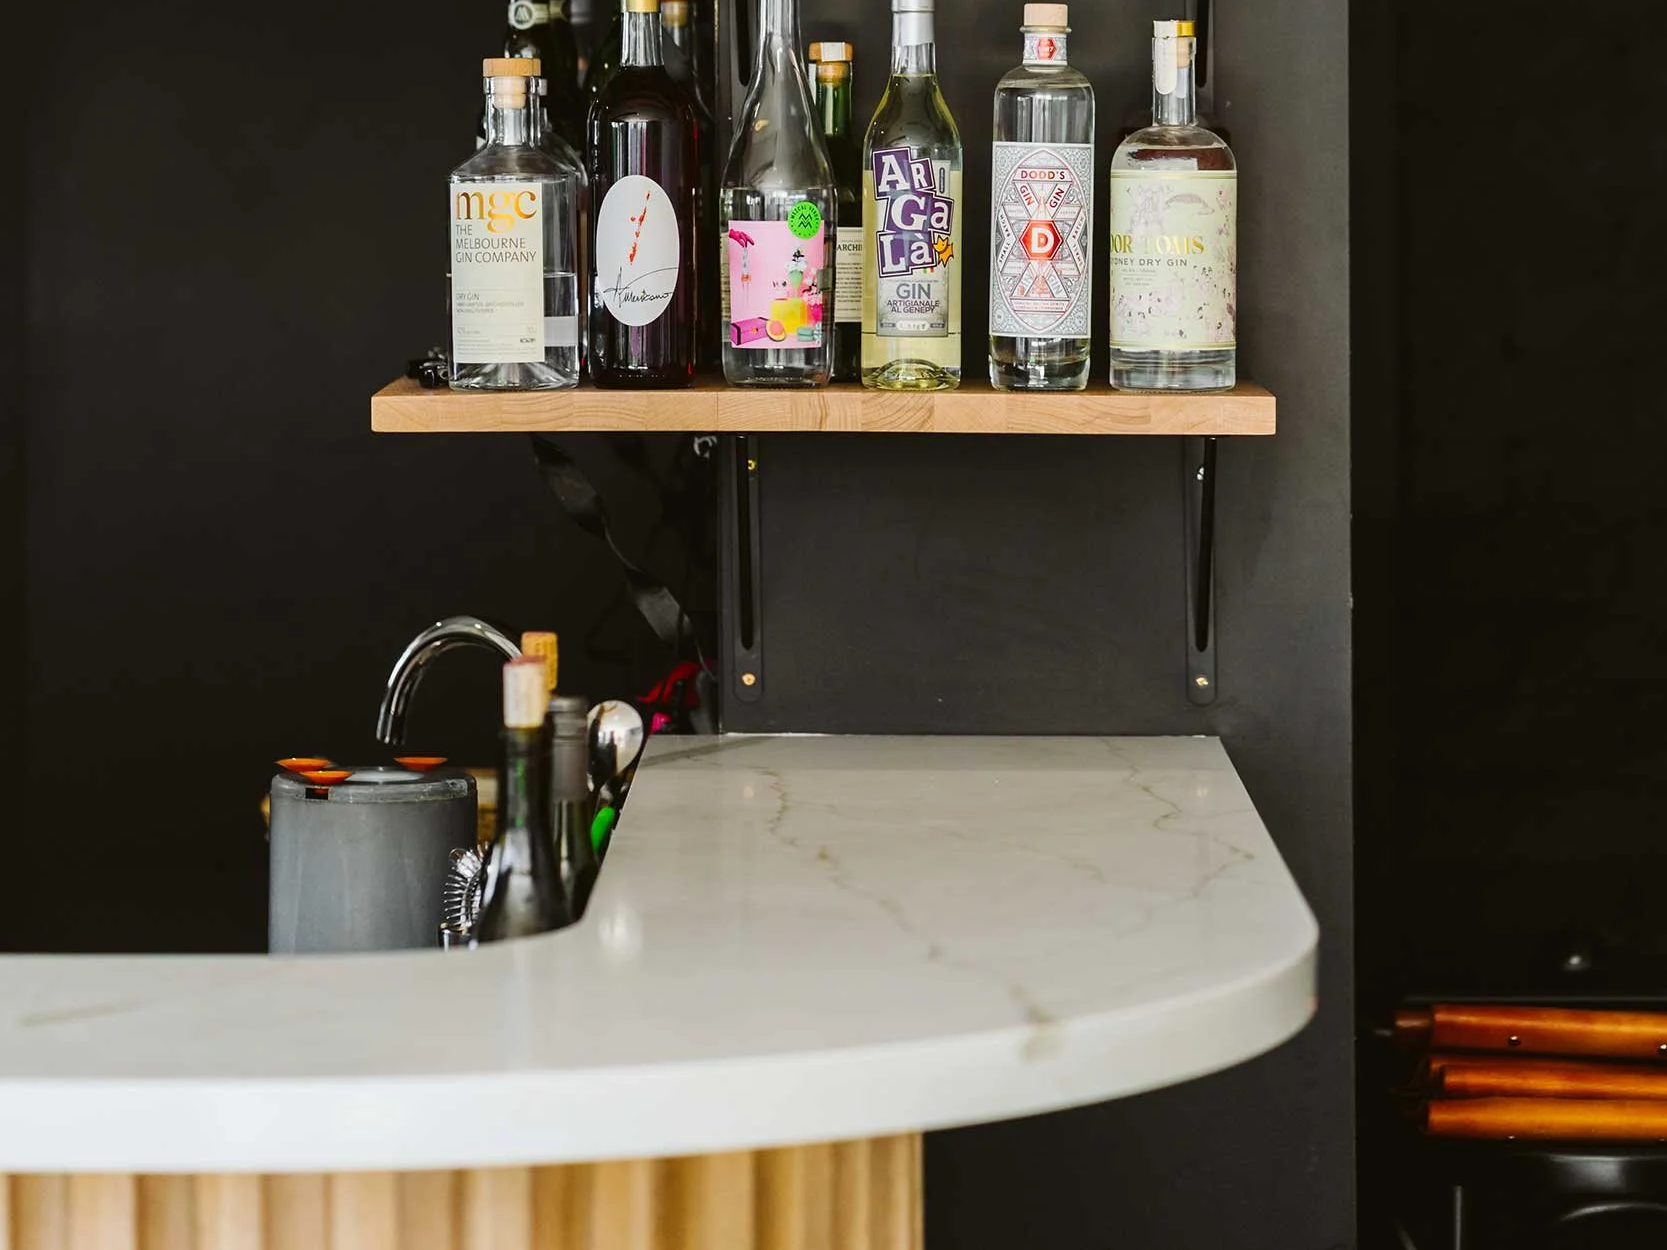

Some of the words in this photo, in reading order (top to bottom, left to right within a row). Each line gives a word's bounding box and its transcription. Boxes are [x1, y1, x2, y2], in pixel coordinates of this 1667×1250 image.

[1020, 170, 1065, 180] DODD'S
[1019, 185, 1035, 206] GIN
[1049, 187, 1065, 208] GIN
[456, 190, 537, 234] mgc
[456, 224, 473, 235] THE
[456, 238, 526, 249] MELBOURNE
[1031, 227, 1055, 253] D
[456, 251, 473, 263] GIN
[475, 251, 537, 263] COMPANY
[1138, 258, 1161, 267] DRY
[1166, 259, 1188, 267] GIN
[896, 283, 931, 299] GIN
[886, 299, 940, 307] ARTIGIANALE
